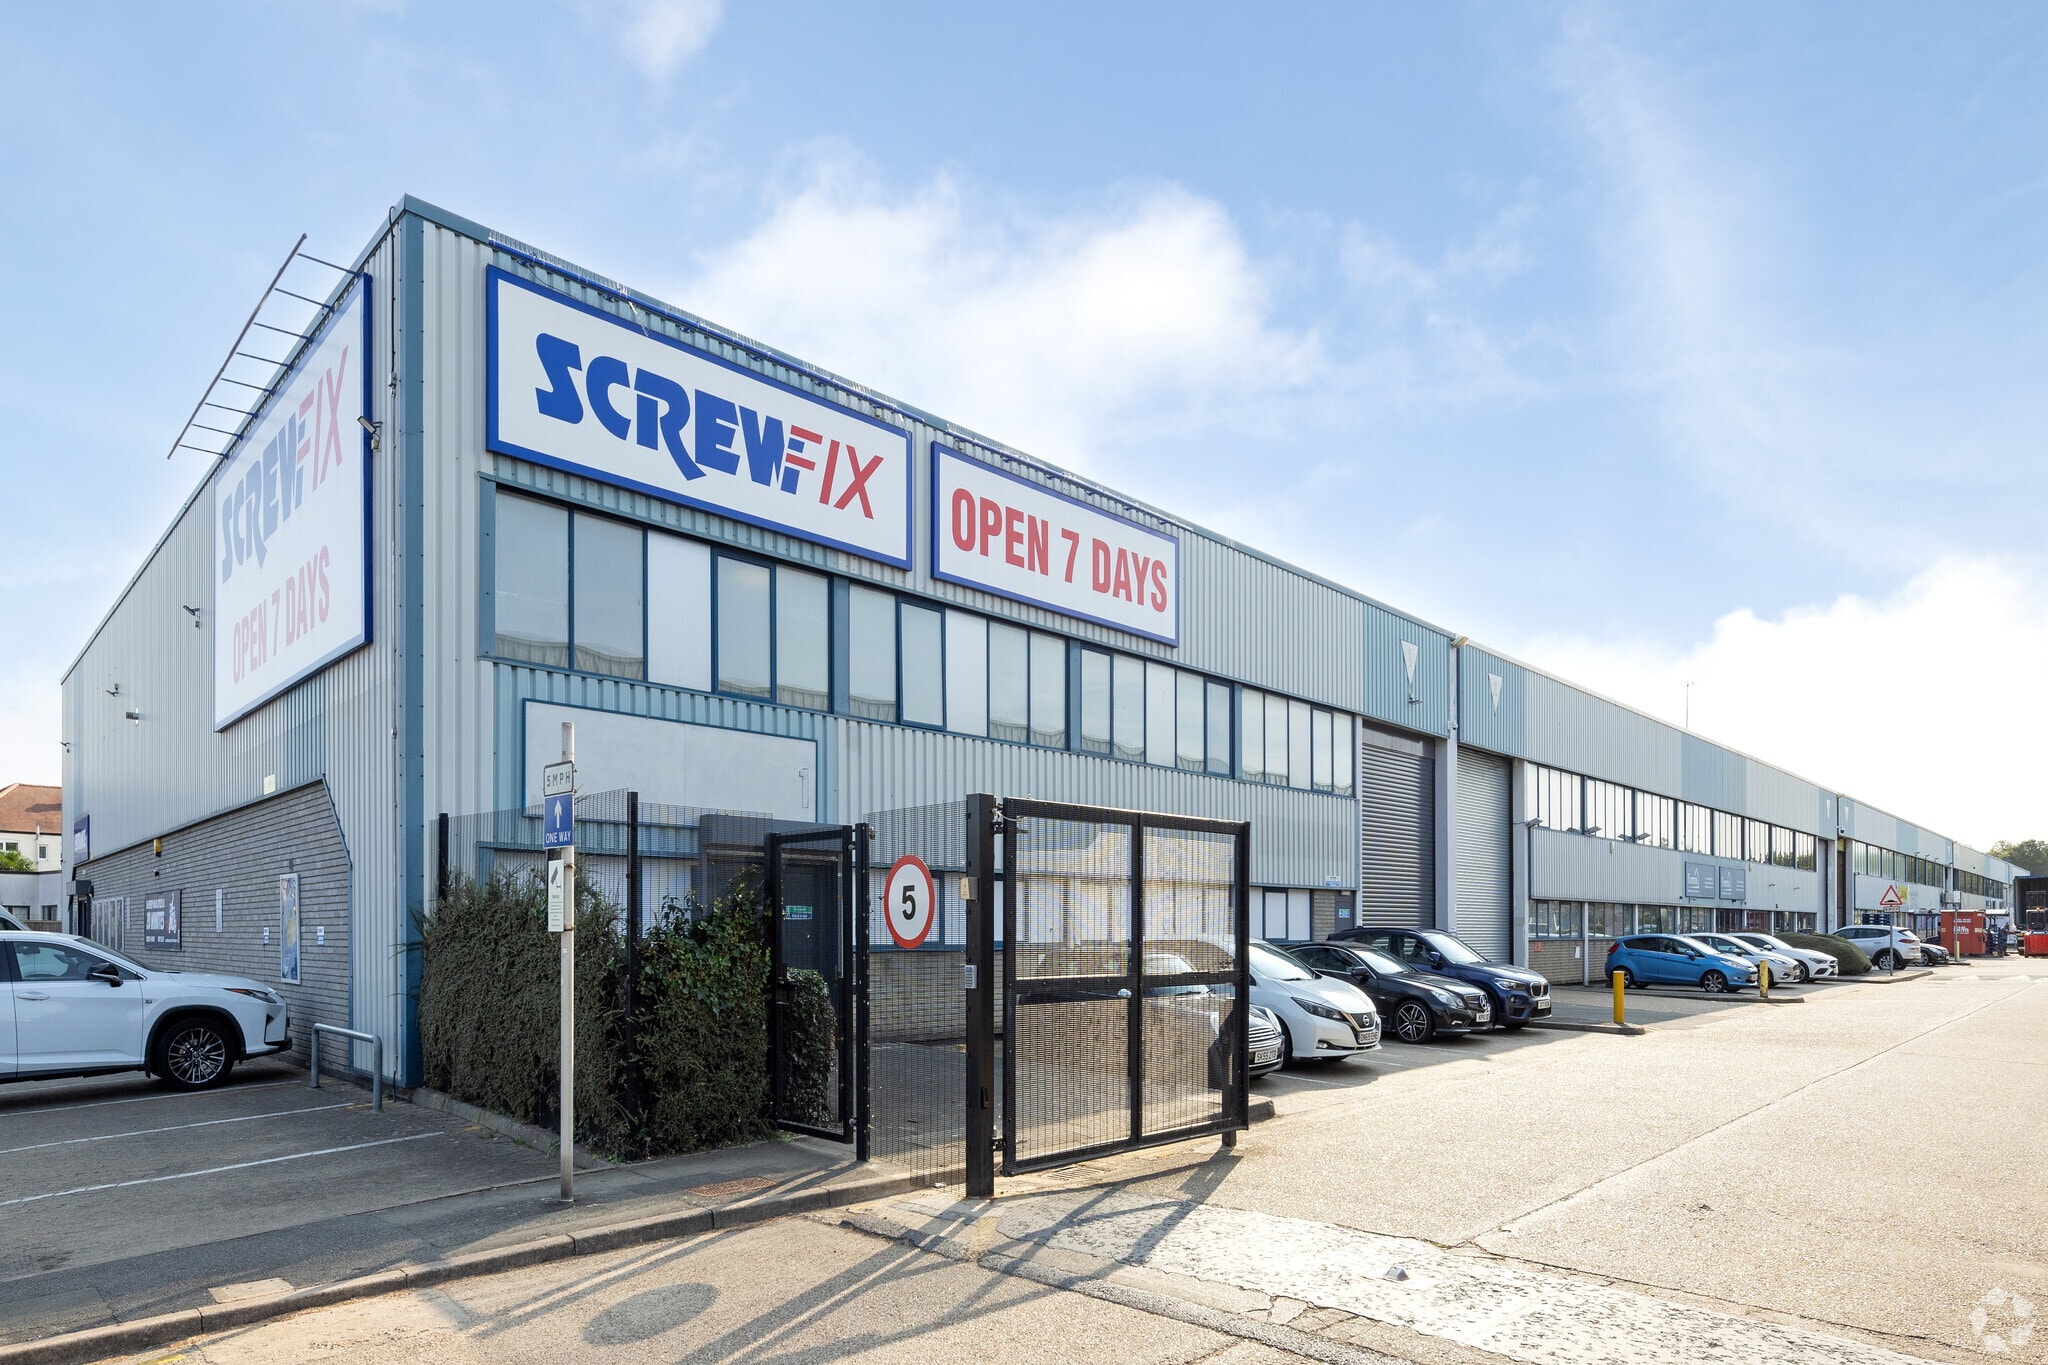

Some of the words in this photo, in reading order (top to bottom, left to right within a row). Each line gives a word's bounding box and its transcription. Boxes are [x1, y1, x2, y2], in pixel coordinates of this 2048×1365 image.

[222, 344, 348, 585] SCREWFIX
[535, 332, 885, 519] SCREWFIX
[233, 598, 267, 685] OPEN
[272, 588, 280, 656] 7
[286, 544, 330, 647] DAYS
[951, 487, 1049, 577] OPEN
[1061, 527, 1080, 584] 7
[1092, 537, 1168, 613] DAYS
[545, 832, 557, 844] ONE
[559, 830, 571, 842] WAY
[902, 884, 916, 920] 5
